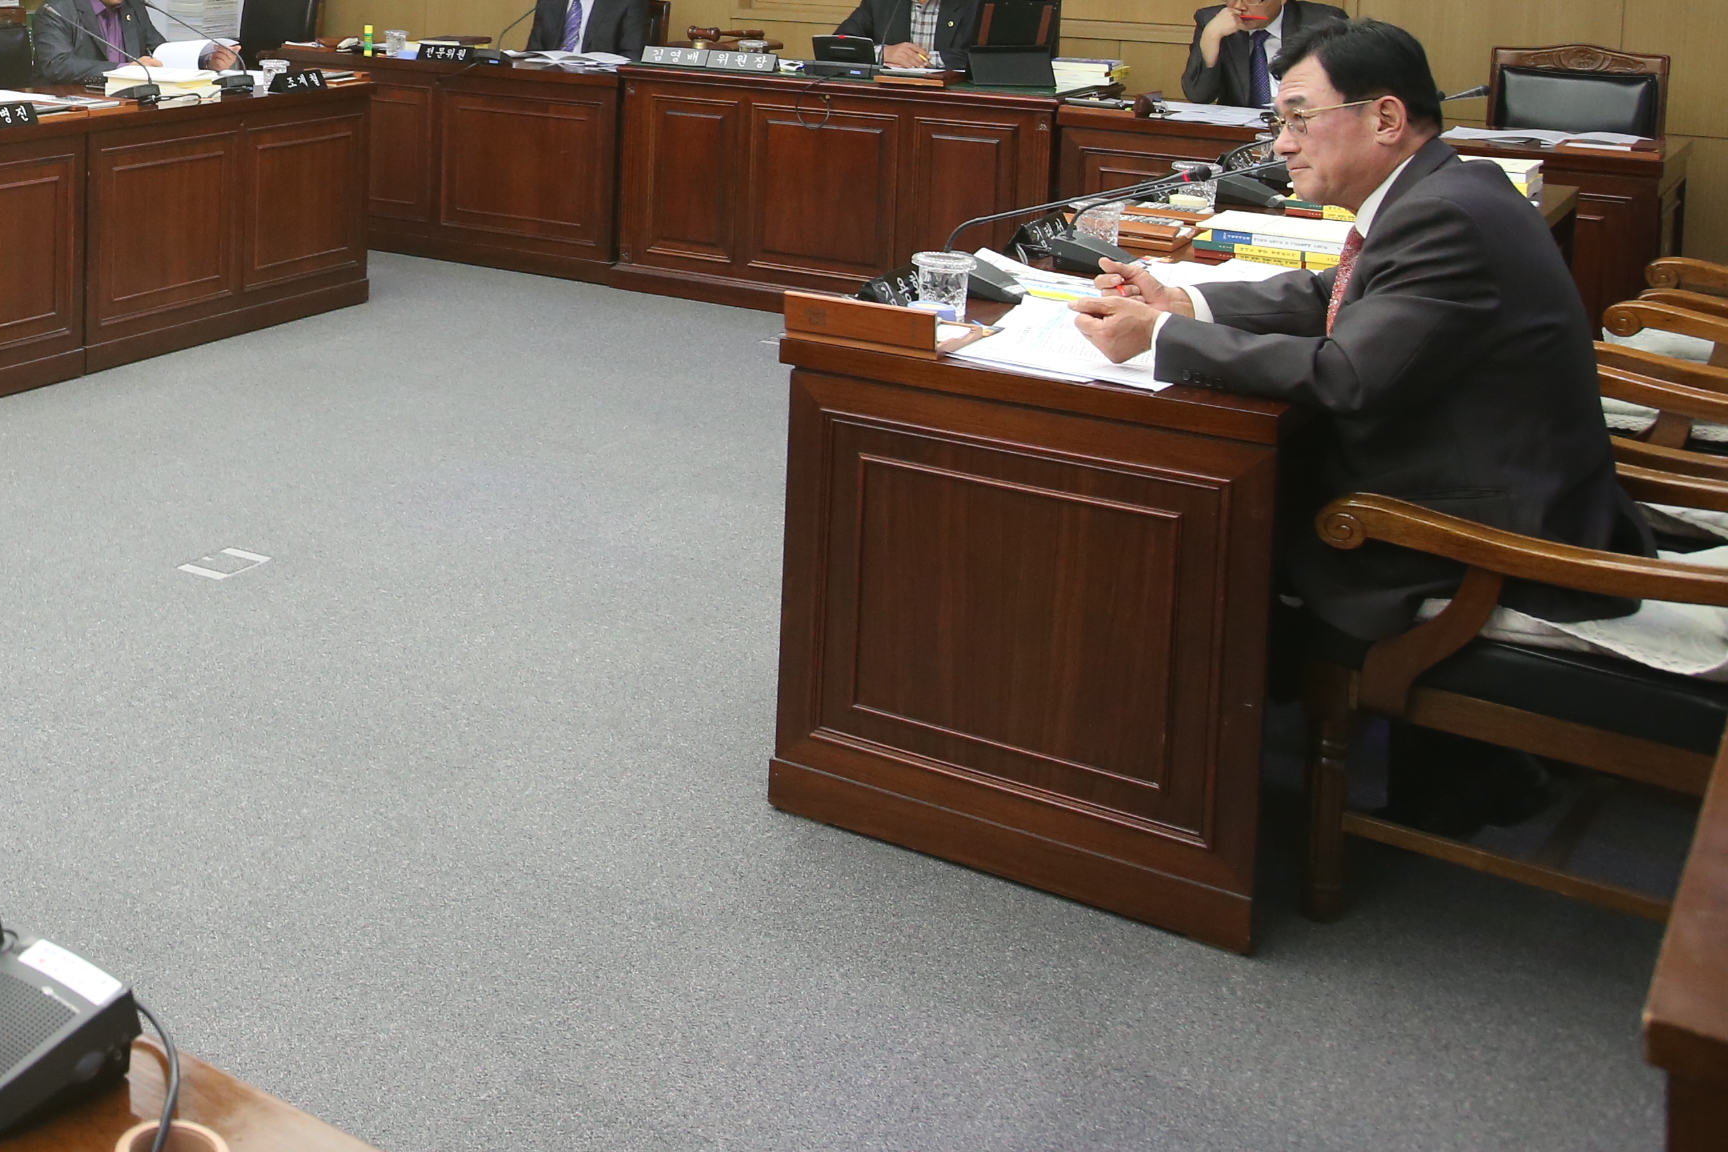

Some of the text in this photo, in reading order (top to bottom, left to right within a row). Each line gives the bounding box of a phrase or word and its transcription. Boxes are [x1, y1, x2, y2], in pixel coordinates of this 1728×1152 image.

[424, 46, 468, 61] 전문위원
[652, 48, 768, 69] 김영배 위원장
